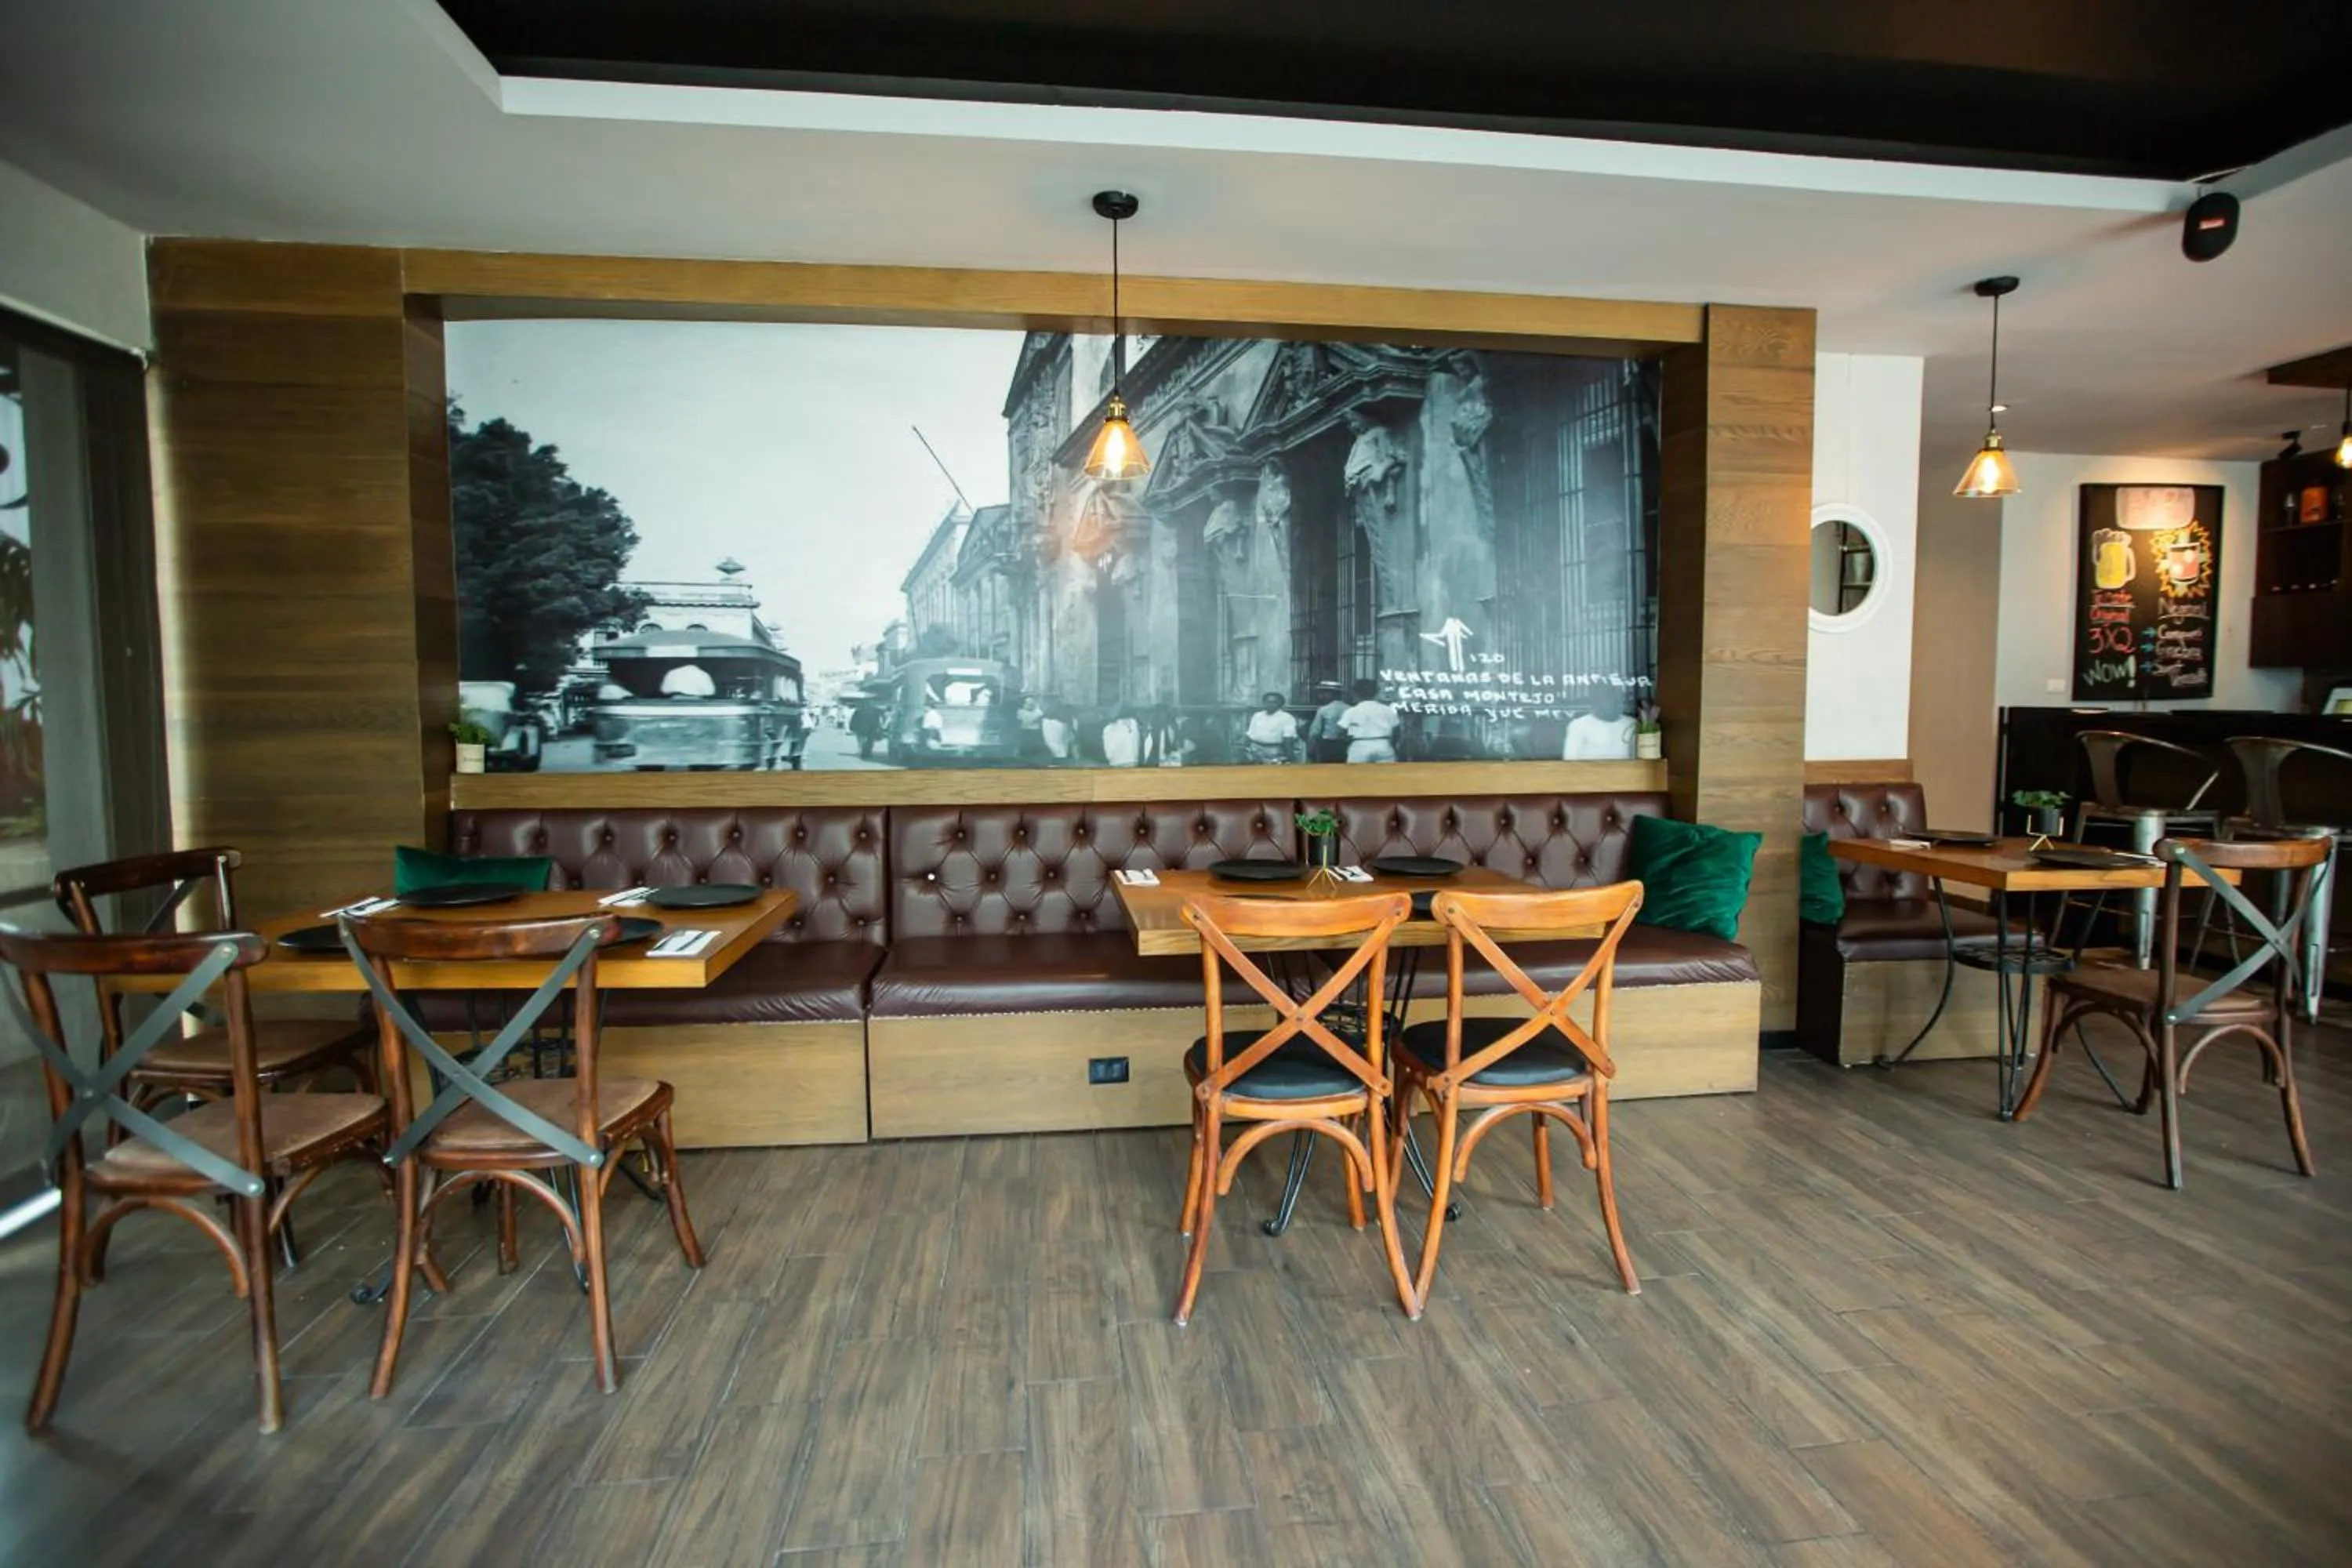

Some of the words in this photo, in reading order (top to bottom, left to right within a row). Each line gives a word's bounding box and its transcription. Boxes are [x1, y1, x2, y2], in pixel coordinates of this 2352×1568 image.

[1497, 672, 1524, 685] DE
[1531, 674, 1555, 687] LA
[1390, 701, 1472, 716] MERIDA
